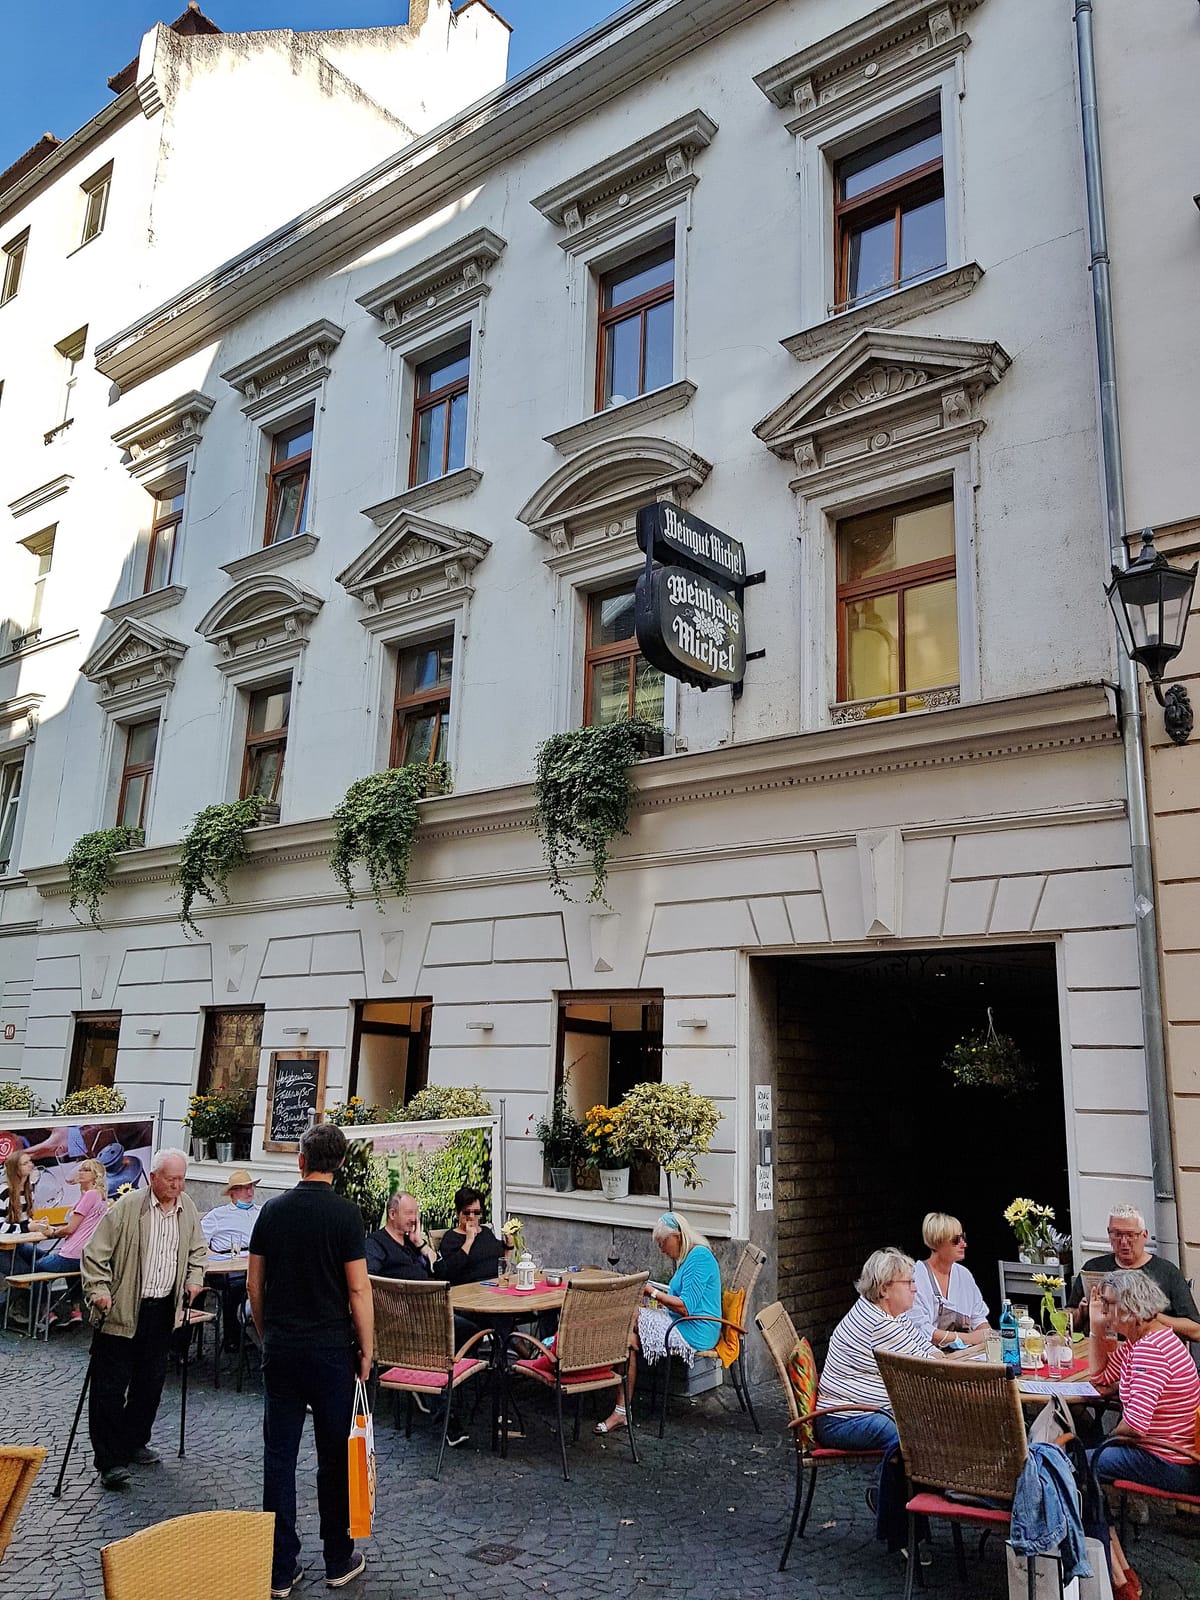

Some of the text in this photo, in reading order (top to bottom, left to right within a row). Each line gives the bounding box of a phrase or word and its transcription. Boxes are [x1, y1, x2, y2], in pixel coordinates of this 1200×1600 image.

[664, 507, 743, 576] Weingut Michel
[667, 575, 739, 634] Weinhaus
[673, 616, 735, 673] Michel
